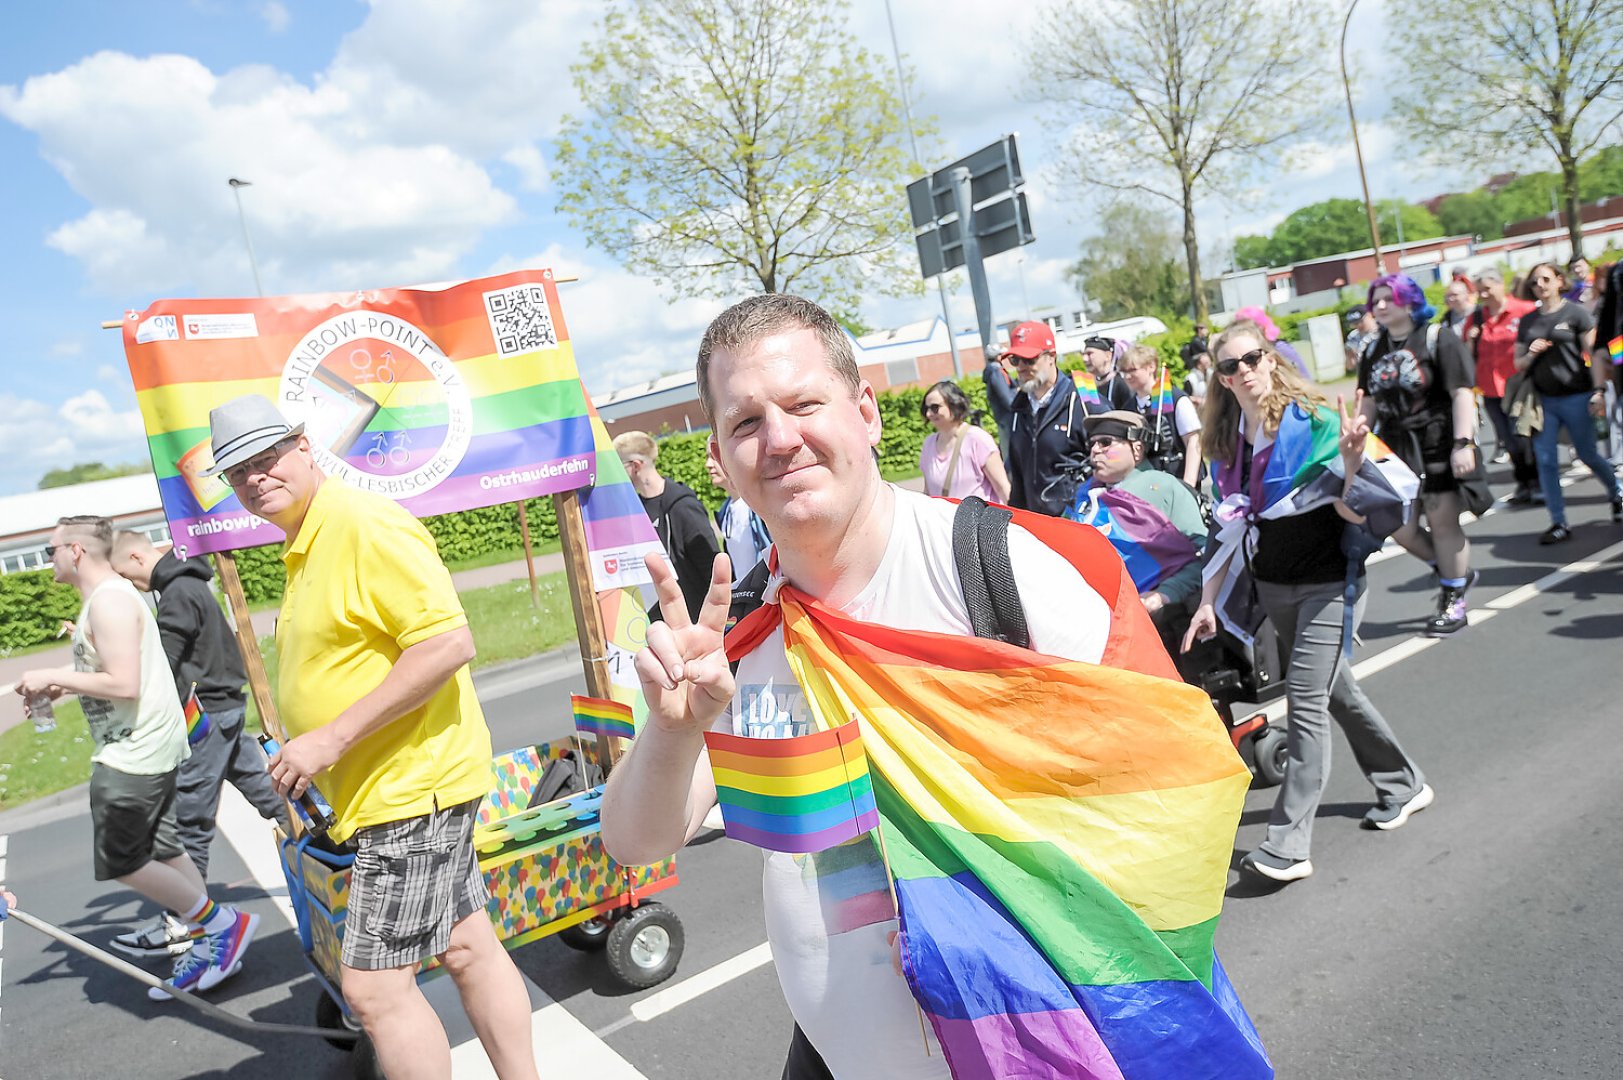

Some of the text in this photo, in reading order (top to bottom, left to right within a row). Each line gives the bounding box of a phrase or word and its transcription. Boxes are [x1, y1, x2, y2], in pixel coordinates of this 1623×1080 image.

[286, 317, 460, 402] RAINBOW-POINT e.V.
[479, 459, 589, 490] Ostrhauderfehn
[748, 692, 807, 724] LOVE
